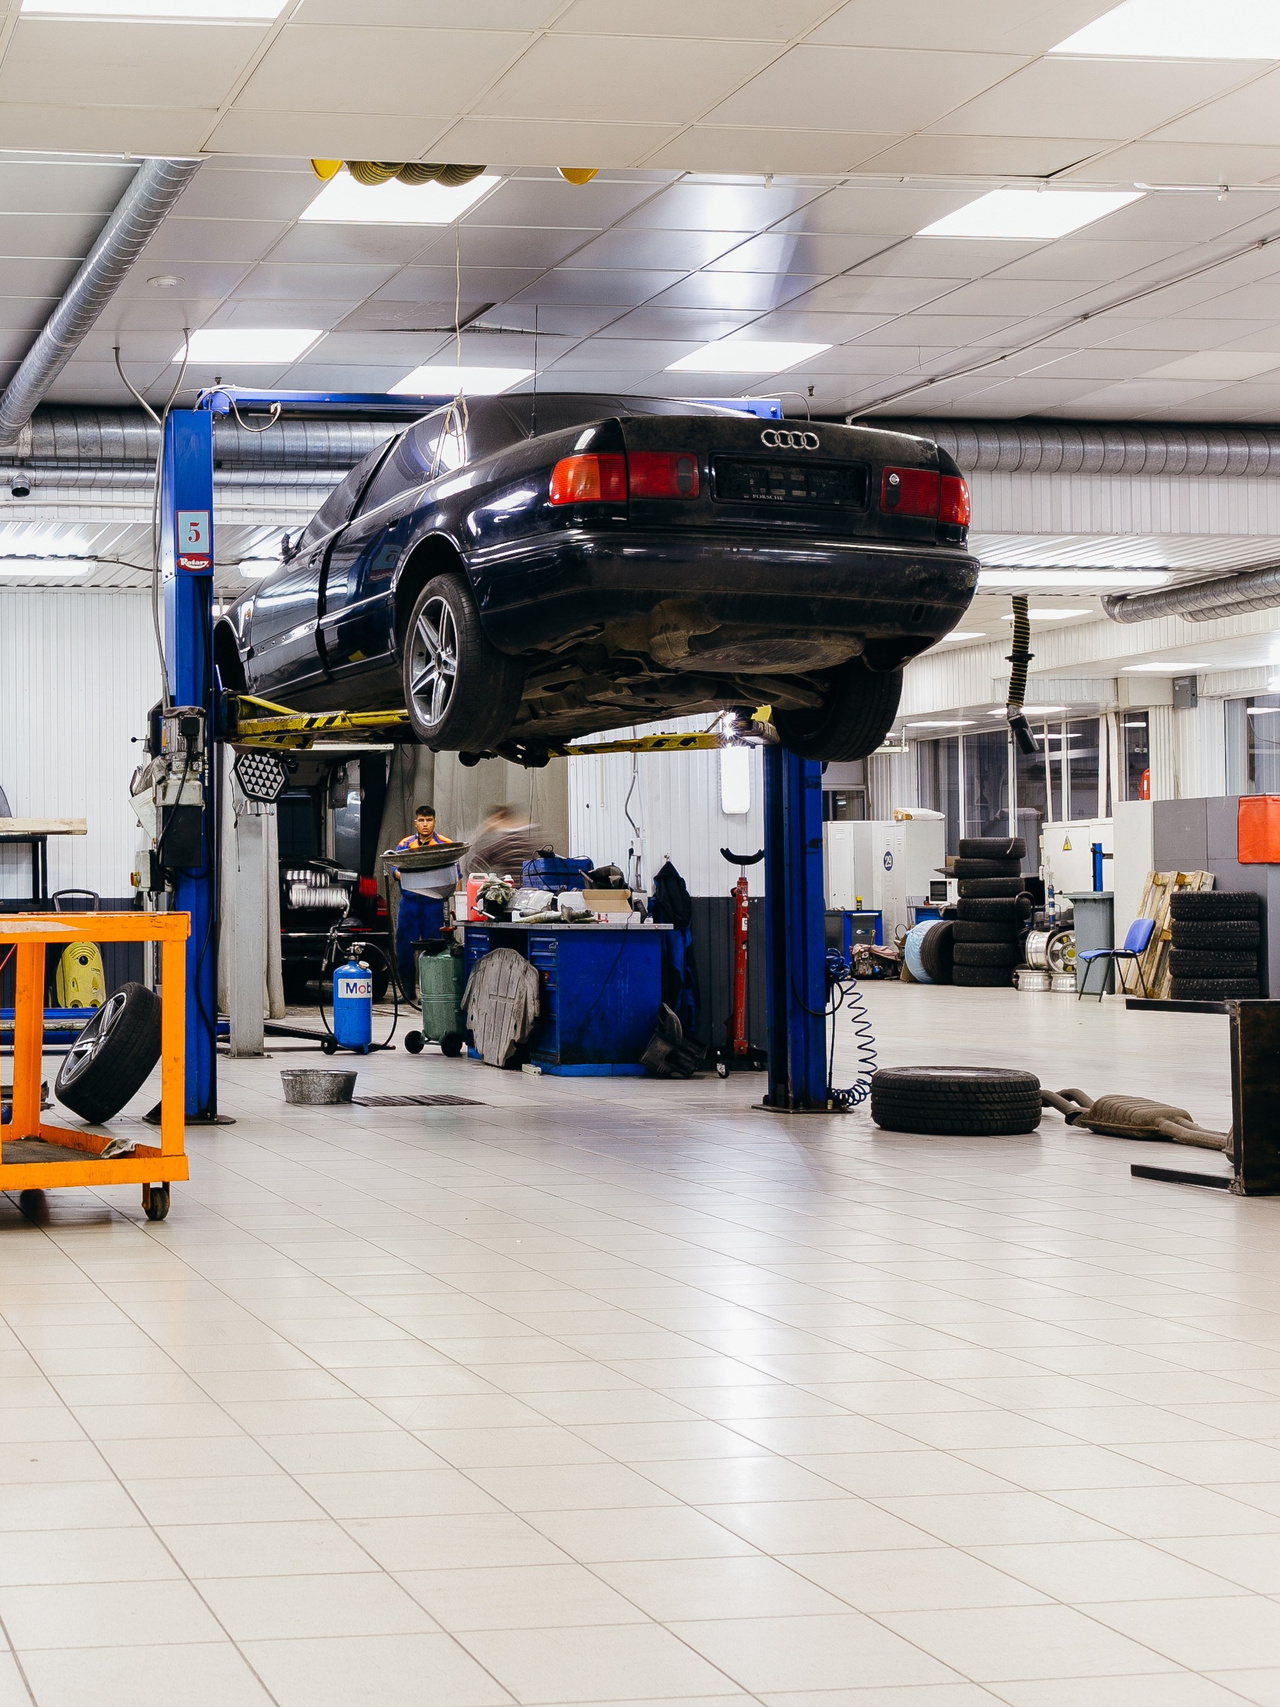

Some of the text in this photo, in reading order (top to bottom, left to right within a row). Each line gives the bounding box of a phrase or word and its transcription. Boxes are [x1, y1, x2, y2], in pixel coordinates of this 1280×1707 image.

[188, 522, 201, 542] 5
[179, 557, 209, 569] Rotary
[884, 855, 893, 867] 29
